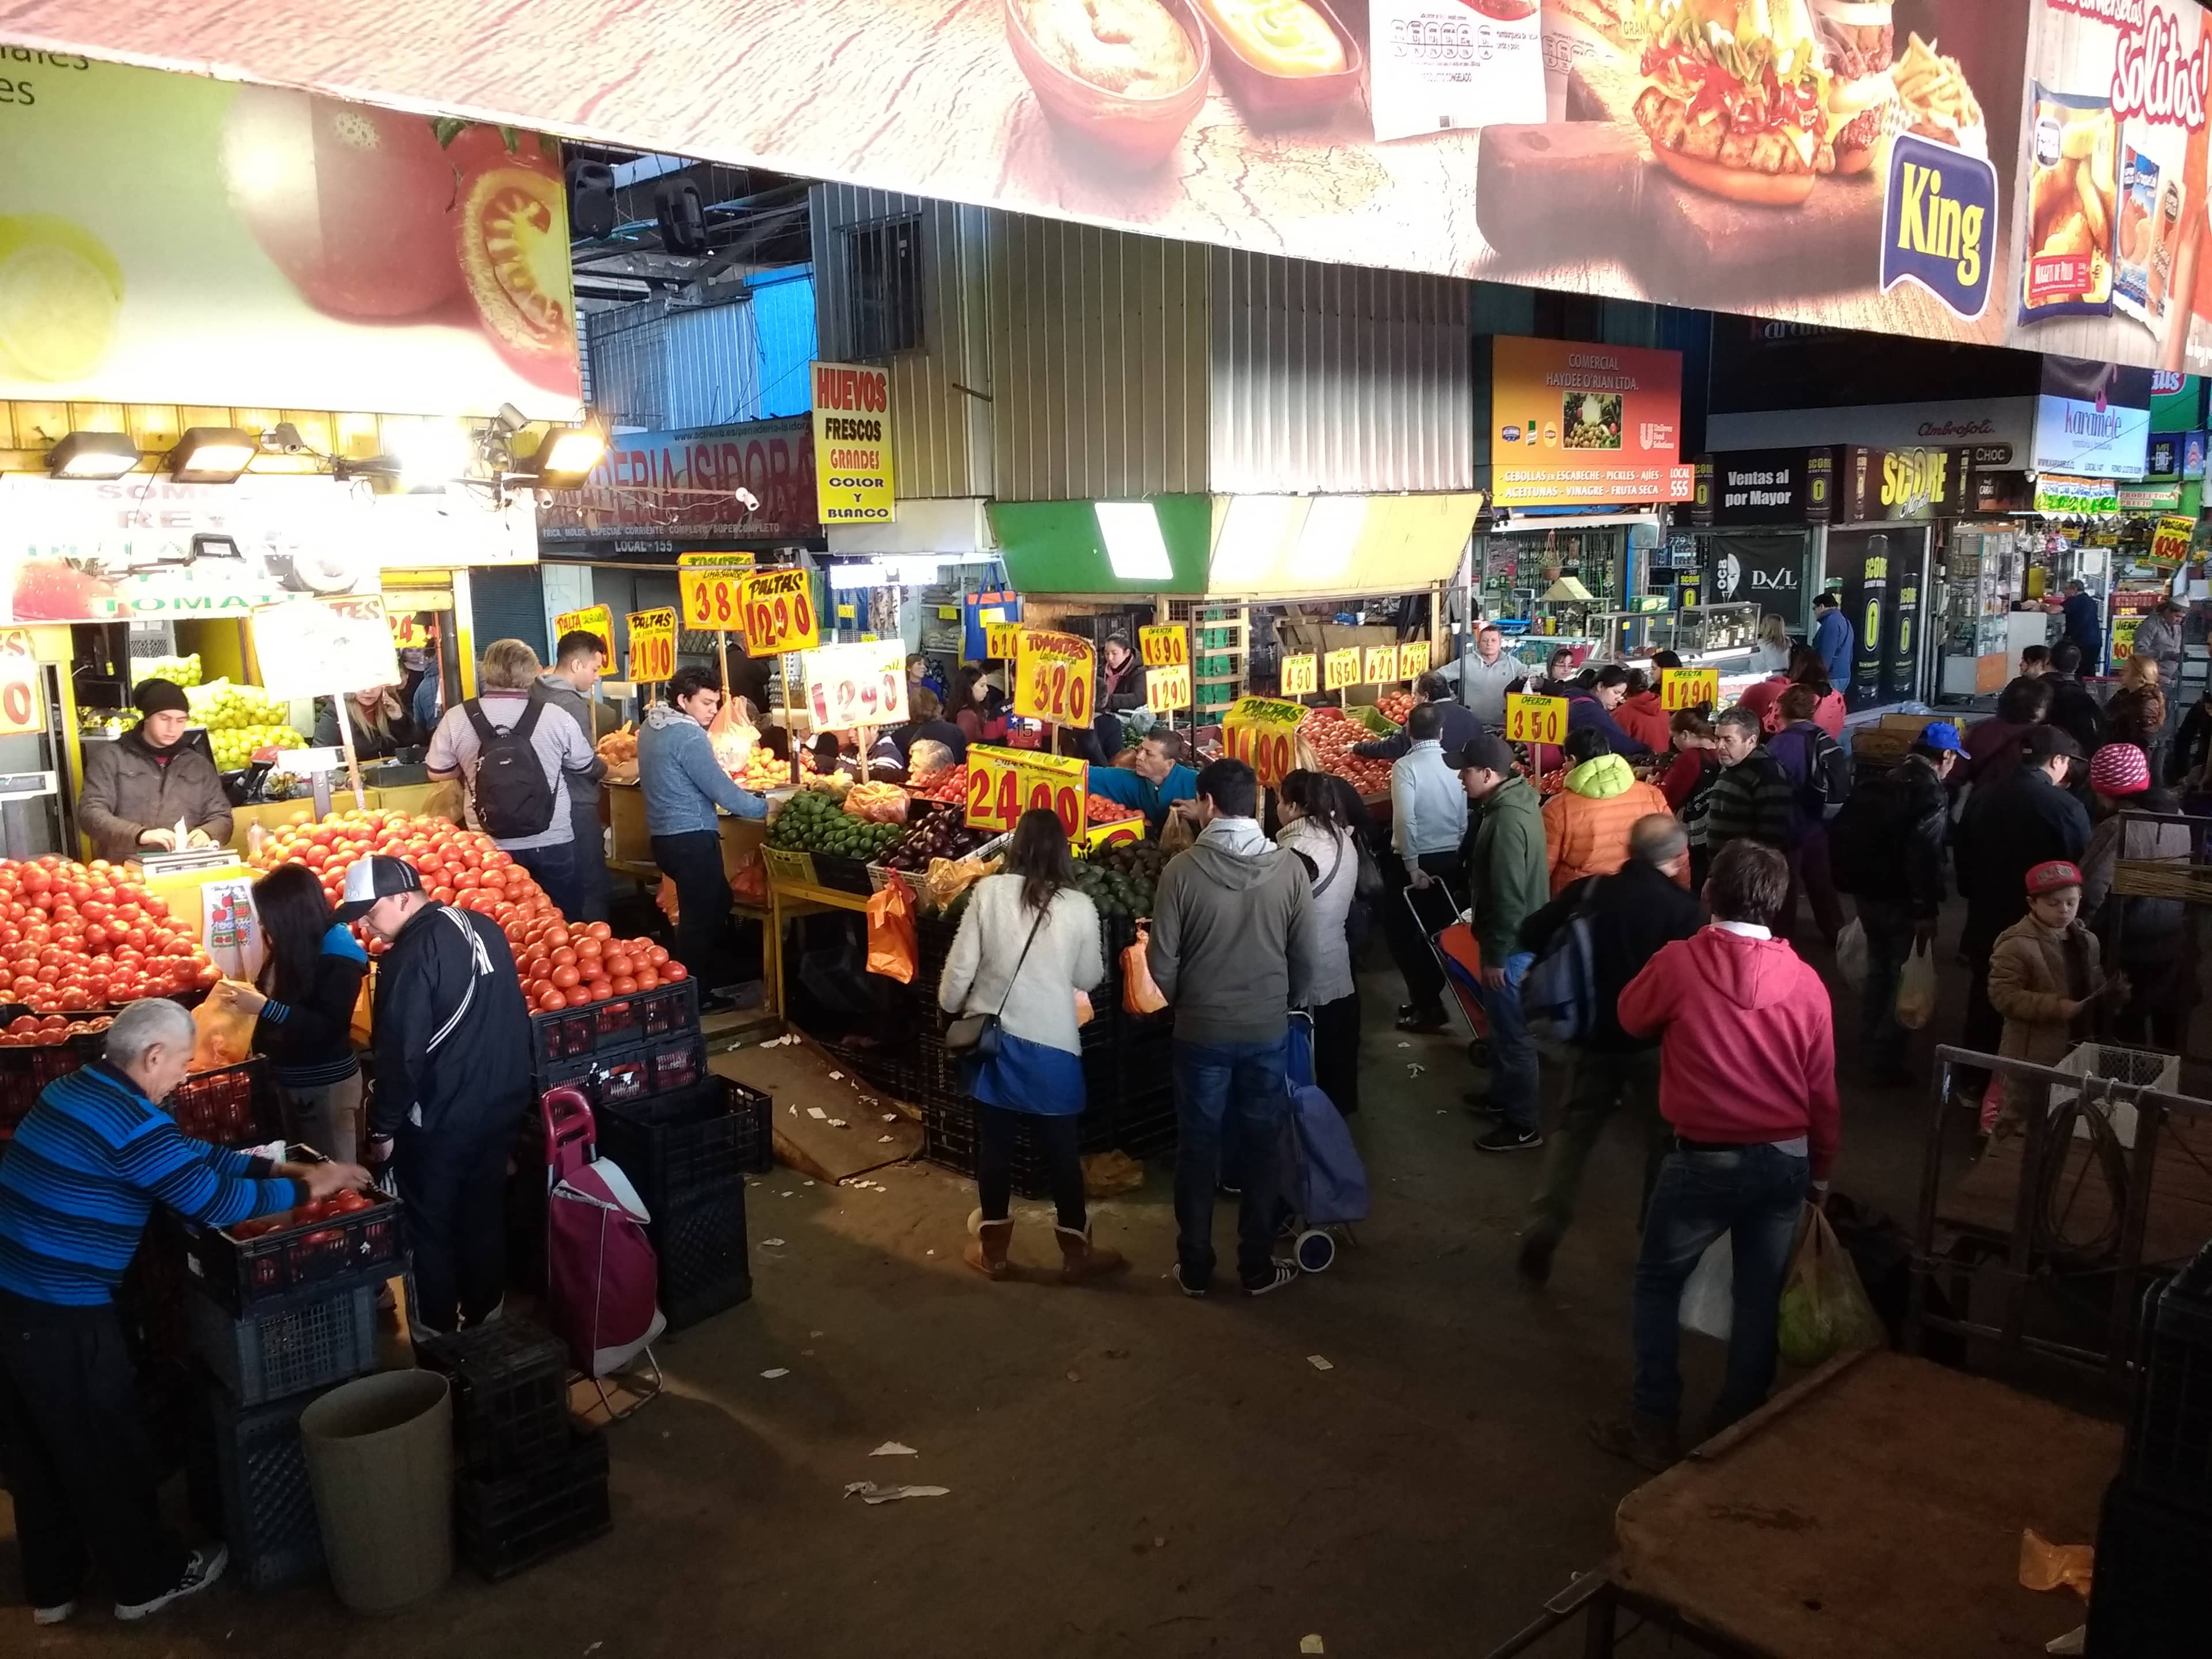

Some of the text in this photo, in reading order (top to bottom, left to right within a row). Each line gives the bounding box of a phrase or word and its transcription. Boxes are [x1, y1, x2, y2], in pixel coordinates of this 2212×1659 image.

[2112, 14, 2210, 127] Solitos!
[1897, 161, 1985, 286] King
[1569, 354, 1619, 371] COMERCIAL
[817, 367, 887, 414] HUEVOS
[1546, 372, 1582, 387] HAYDEE
[1615, 377, 1639, 391] LTDA.
[825, 417, 882, 442] FRESCOS
[830, 448, 880, 471] GRANDES
[1975, 448, 2005, 461] CHOC
[828, 477, 884, 488] COLOR
[1505, 471, 1546, 482] CEBOLLAS
[1556, 470, 1600, 481] ESCABECHE
[1606, 470, 1635, 480] PICKLES
[1670, 468, 1690, 479] LOCAL
[1728, 469, 1790, 486] Ventas al
[1881, 447, 1949, 506] SCORE
[853, 493, 862, 503] Y
[1505, 484, 1658, 498] ACEITUNAS VINAGRE FRUTA SECA
[1669, 480, 1688, 497] 555
[1725, 490, 1791, 507] por Mayor
[828, 509, 889, 518] BLANCO
[625, 525, 665, 535] CORRIENTE
[713, 523, 780, 533] SUPERCOMPLETO
[615, 540, 673, 553] LOCAL 155
[1669, 537, 1686, 546] 779
[748, 572, 804, 600] PALTAS
[556, 613, 582, 632] PALTA
[632, 612, 672, 631] PALTAS
[1026, 633, 1088, 661] TOMATES
[1144, 635, 1181, 664] 1390
[1330, 658, 1357, 685] 1850
[1369, 656, 1393, 681] 620
[1402, 653, 1427, 676] 2650
[1286, 666, 1311, 691] 450
[1034, 665, 1085, 720] 320
[1521, 696, 1552, 706] OFERTA
[1668, 680, 1712, 707] 1290
[1513, 709, 1557, 743] 350
